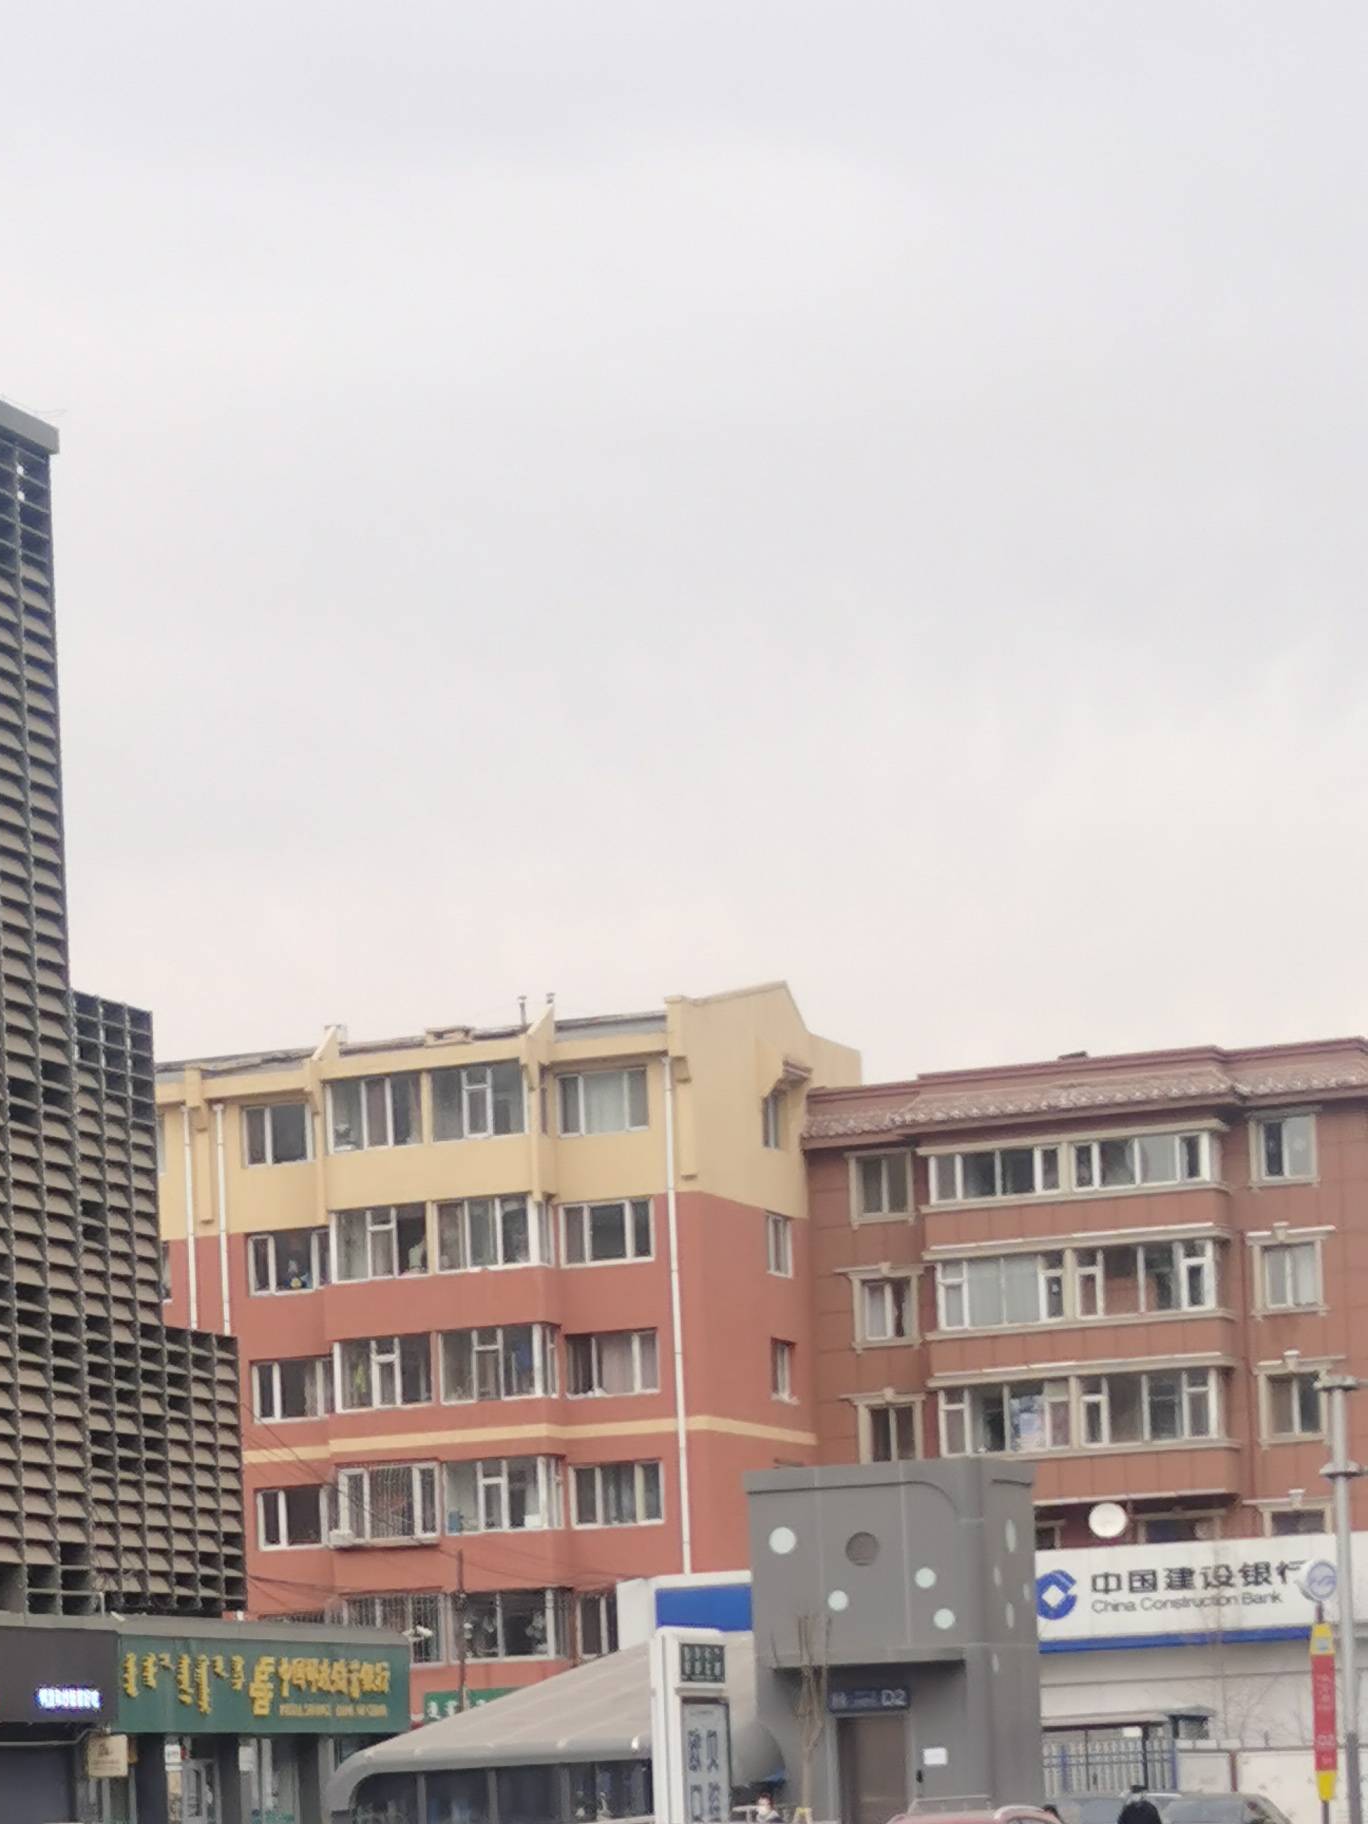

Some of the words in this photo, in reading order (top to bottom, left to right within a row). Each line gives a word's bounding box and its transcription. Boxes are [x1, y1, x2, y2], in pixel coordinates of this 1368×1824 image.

[1091, 1597, 1137, 1614] China
[1140, 1594, 1235, 1611] Construction
[1241, 1590, 1283, 1606] Bank
